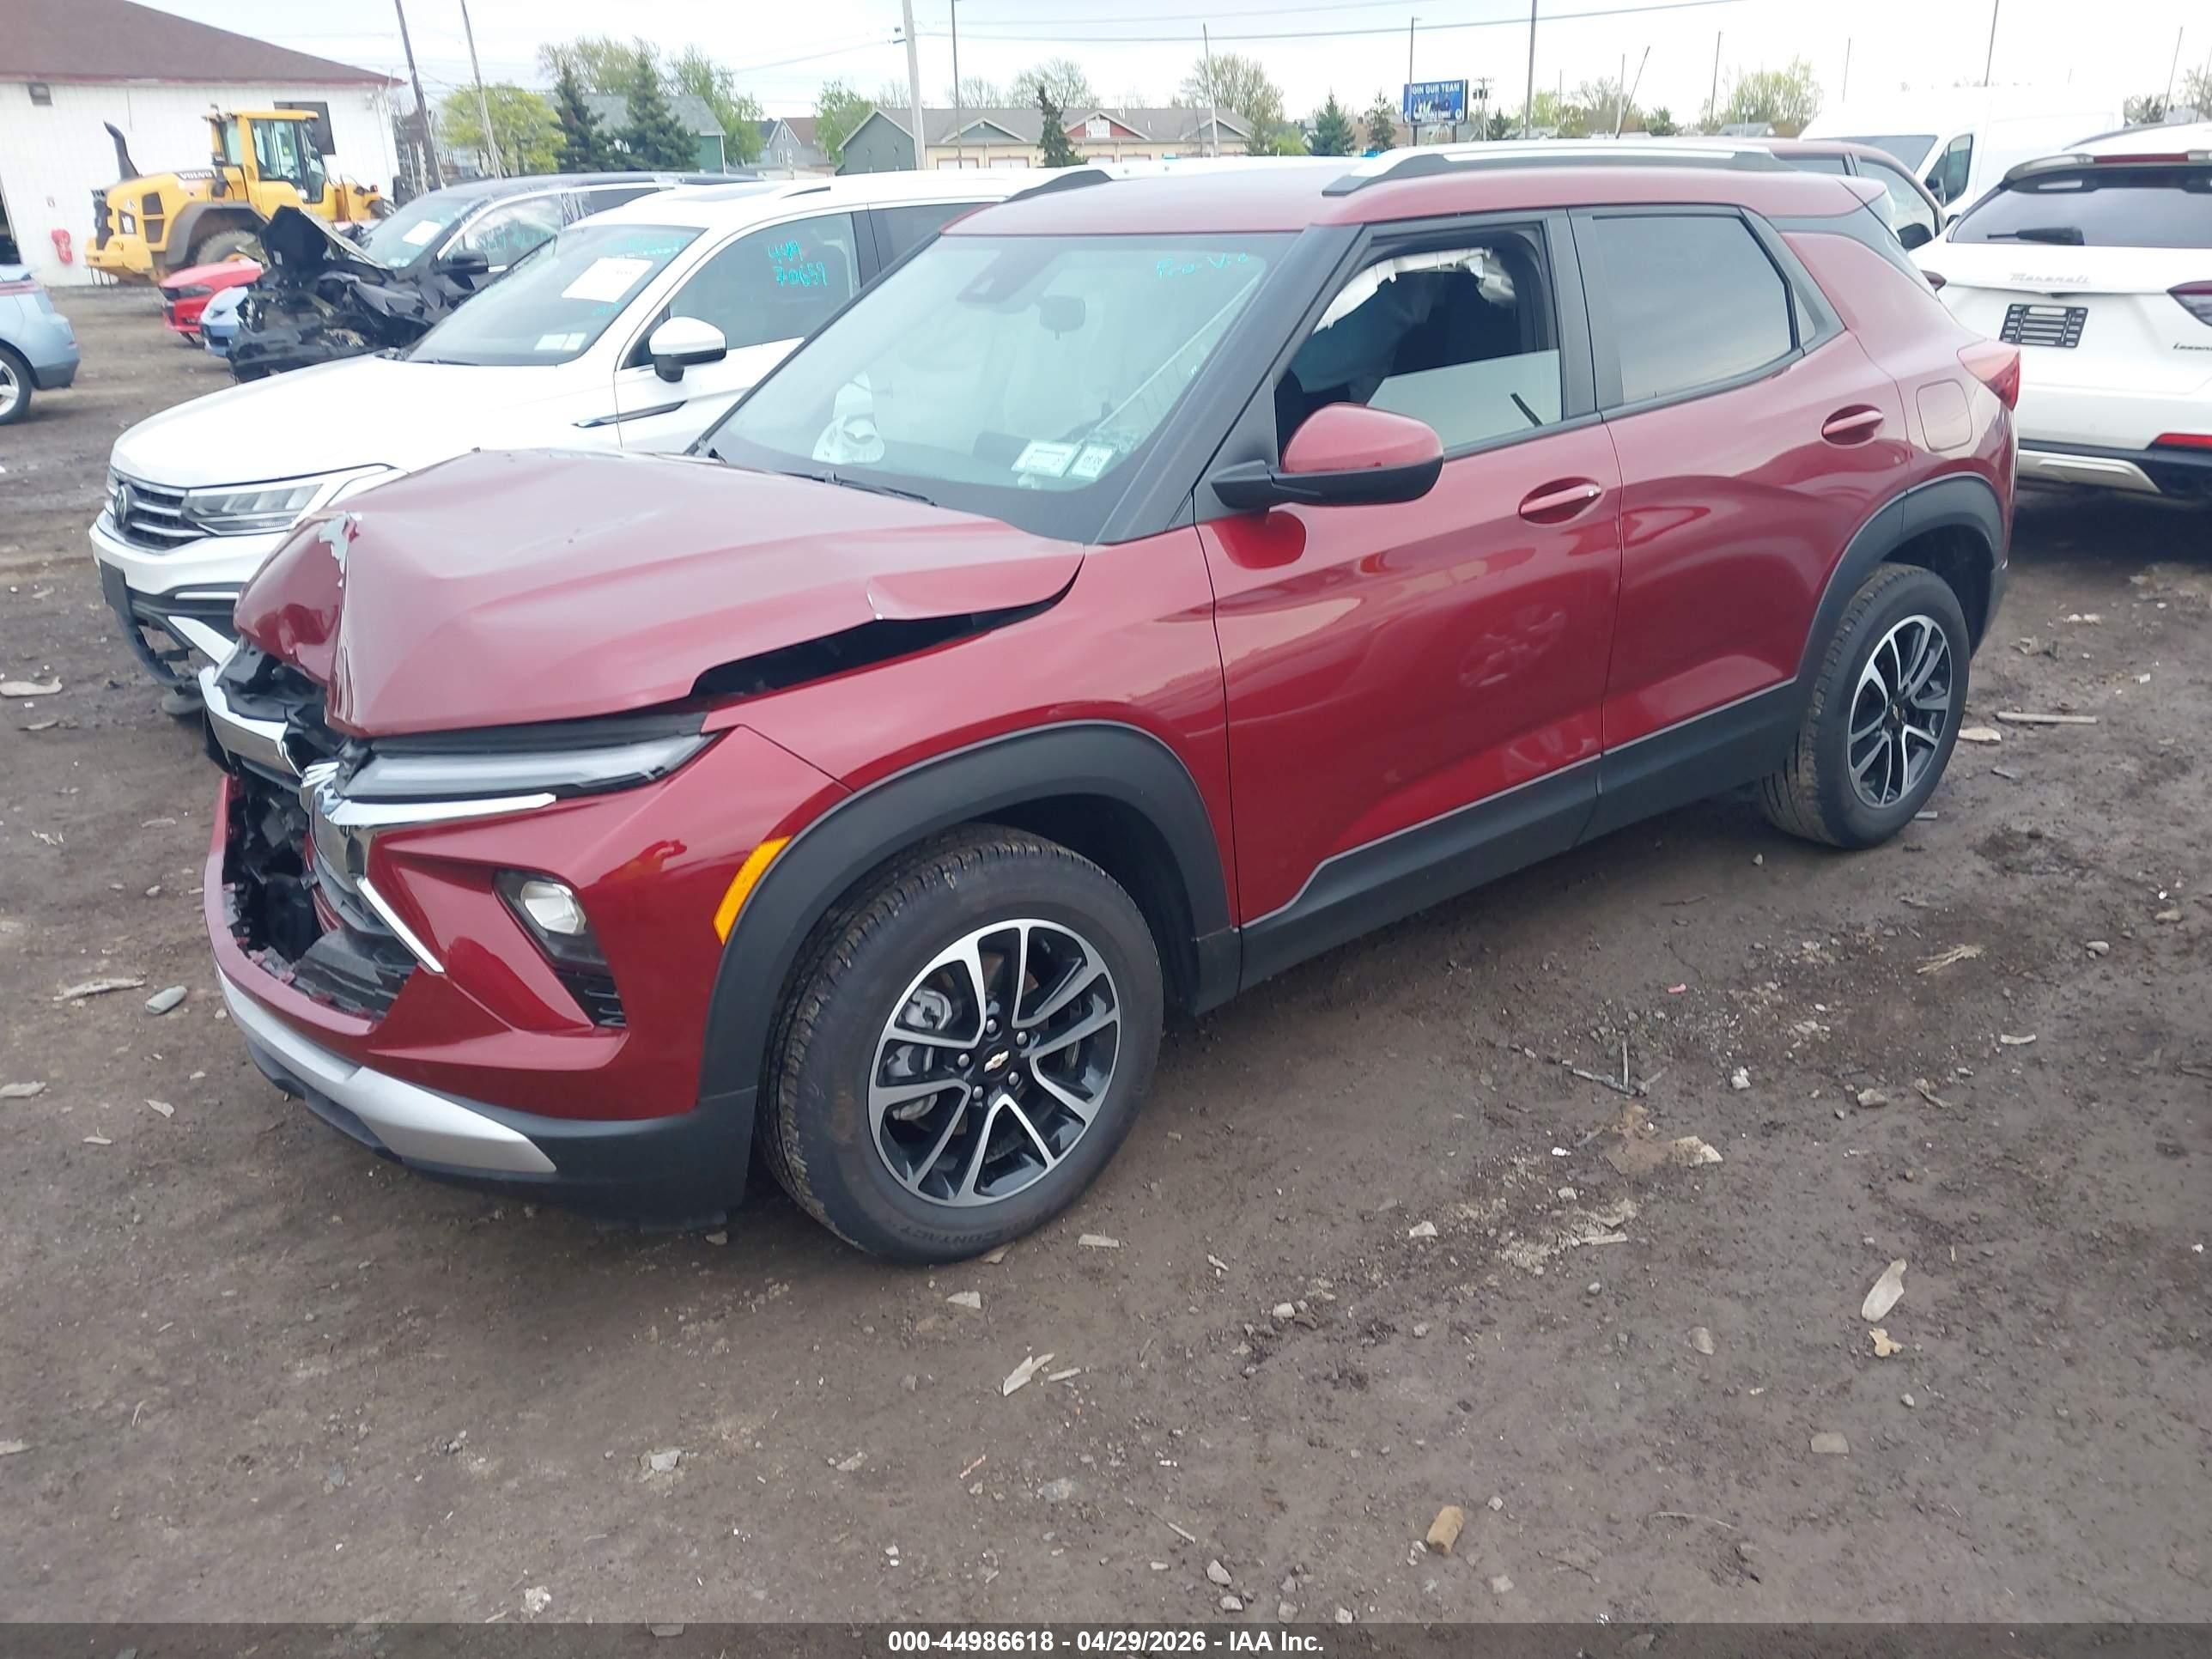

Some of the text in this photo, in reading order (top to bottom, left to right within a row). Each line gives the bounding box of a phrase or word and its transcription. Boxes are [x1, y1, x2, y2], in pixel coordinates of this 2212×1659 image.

[1410, 82, 1461, 95] OIN OUR TEAM
